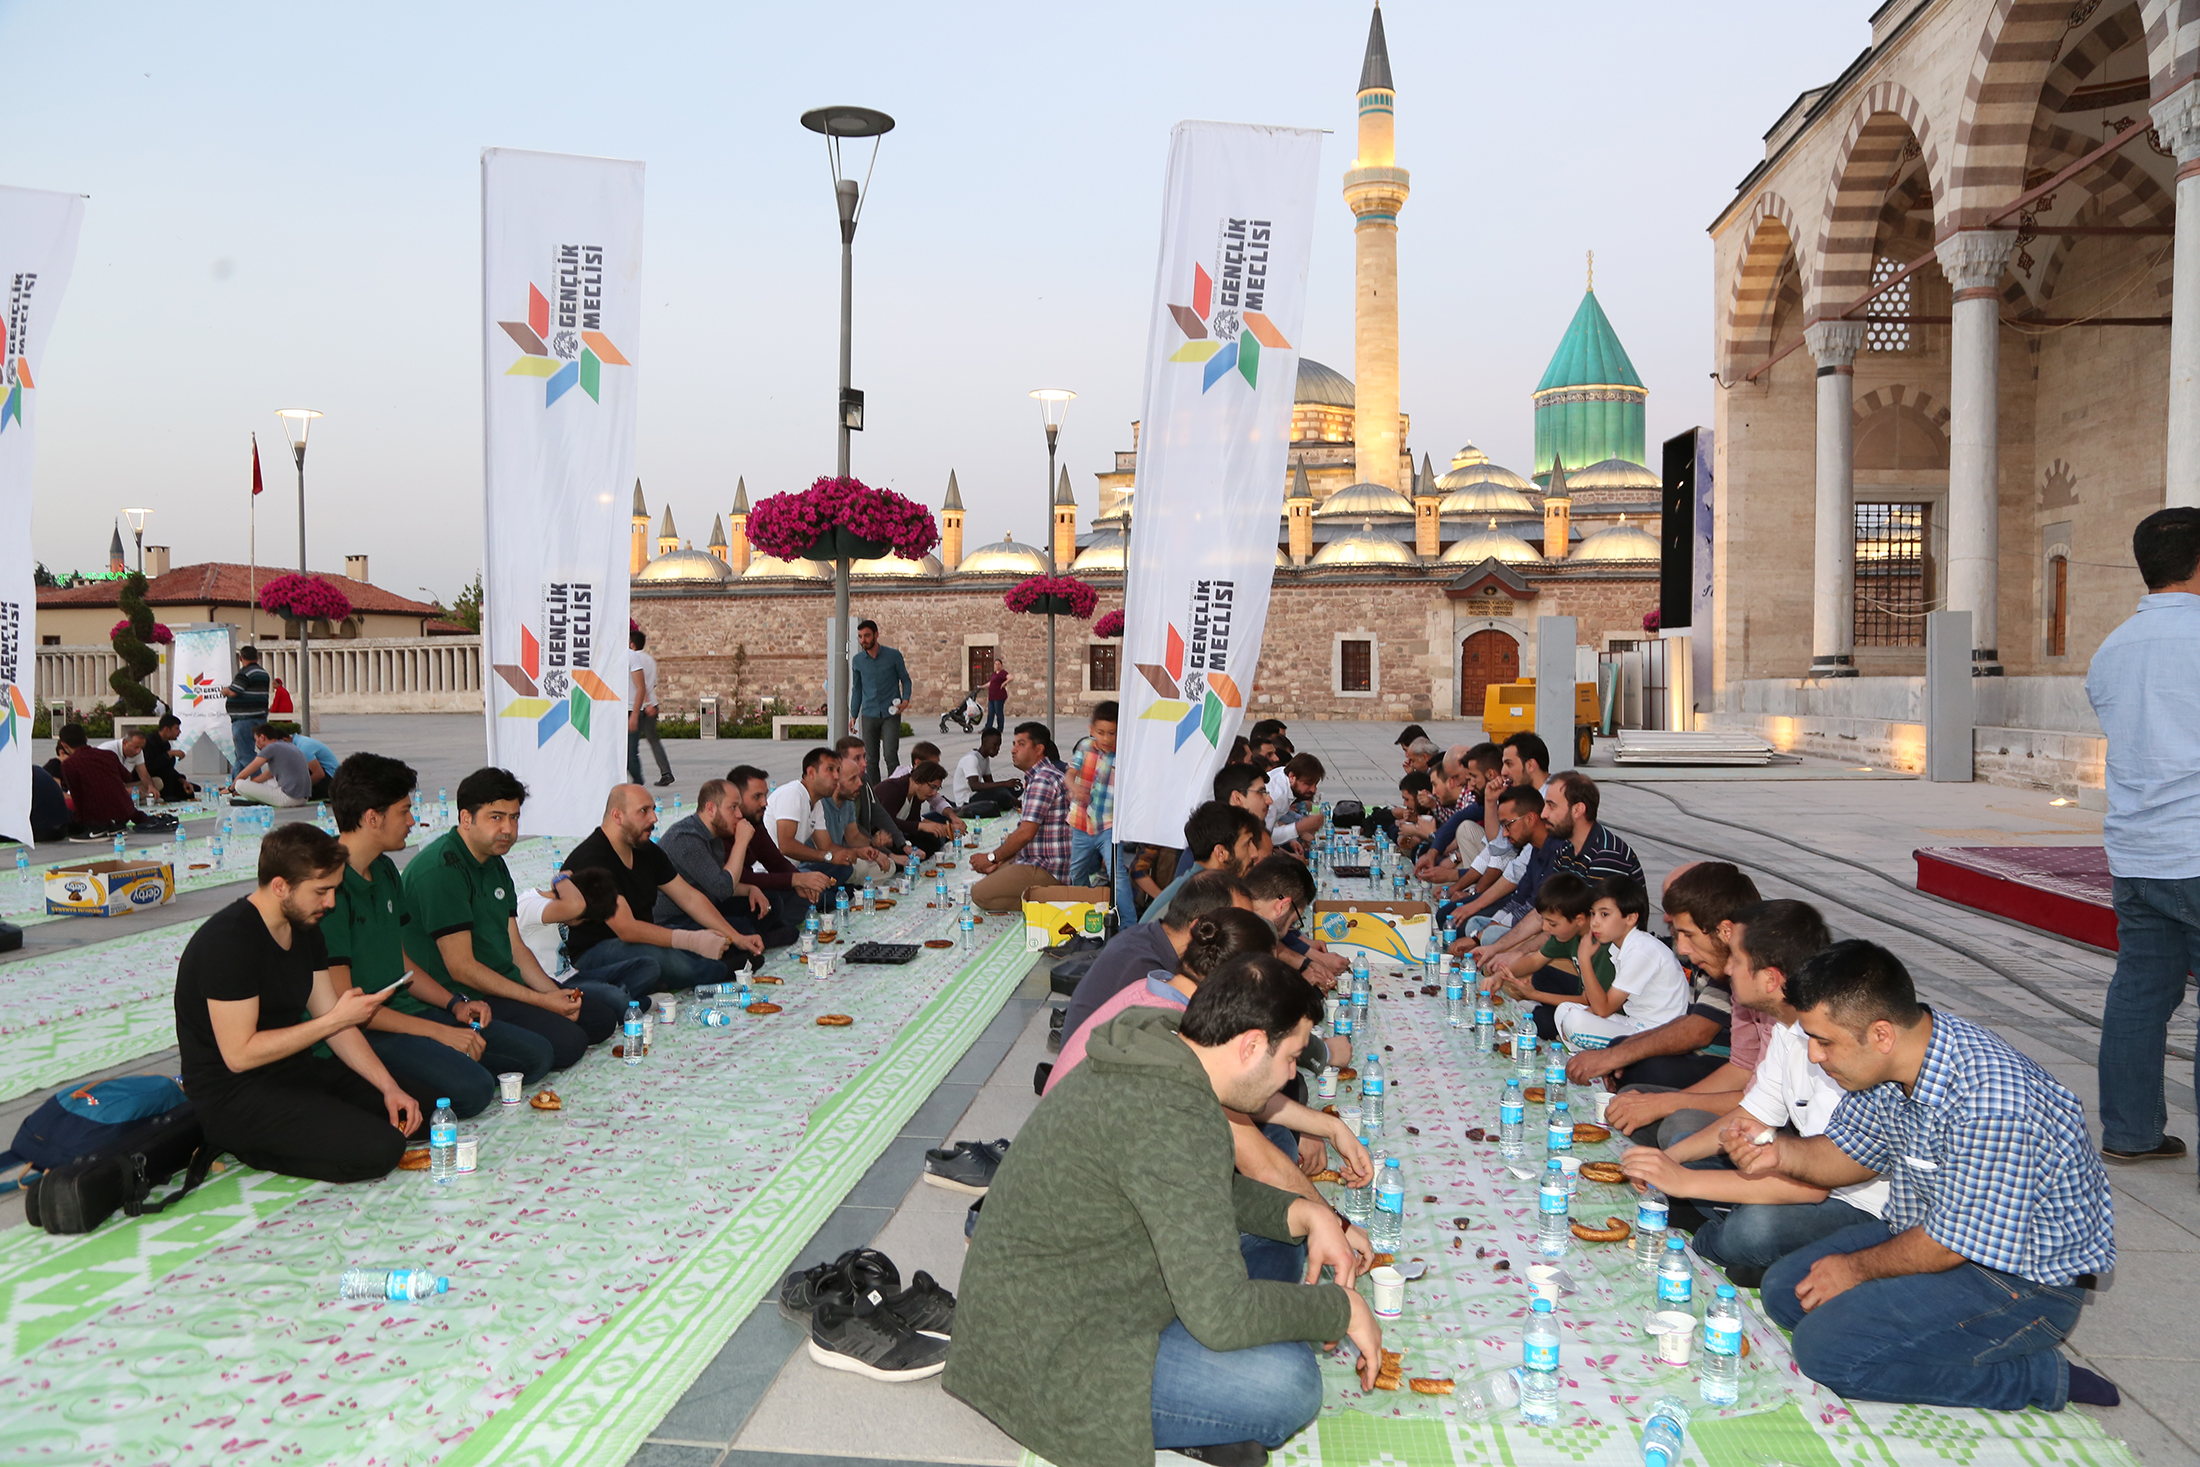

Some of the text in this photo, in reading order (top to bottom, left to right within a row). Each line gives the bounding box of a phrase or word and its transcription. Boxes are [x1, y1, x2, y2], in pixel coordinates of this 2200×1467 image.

[557, 244, 582, 327] GENÇLİK
[582, 245, 603, 329] MECLİSİ
[1221, 217, 1247, 307] GENÇLİK
[1245, 220, 1271, 311] MECLİSİ
[9, 602, 20, 684] MECLİSİ
[546, 582, 571, 667] GENÇLİK
[570, 583, 592, 668] MECLİSİ
[1190, 579, 1212, 669] GENÇLİK
[1209, 580, 1234, 671] MECLİSİ
[51, 906, 77, 914] BANANAS
[66, 882, 87, 893] derby
[132, 886, 160, 902] derby
